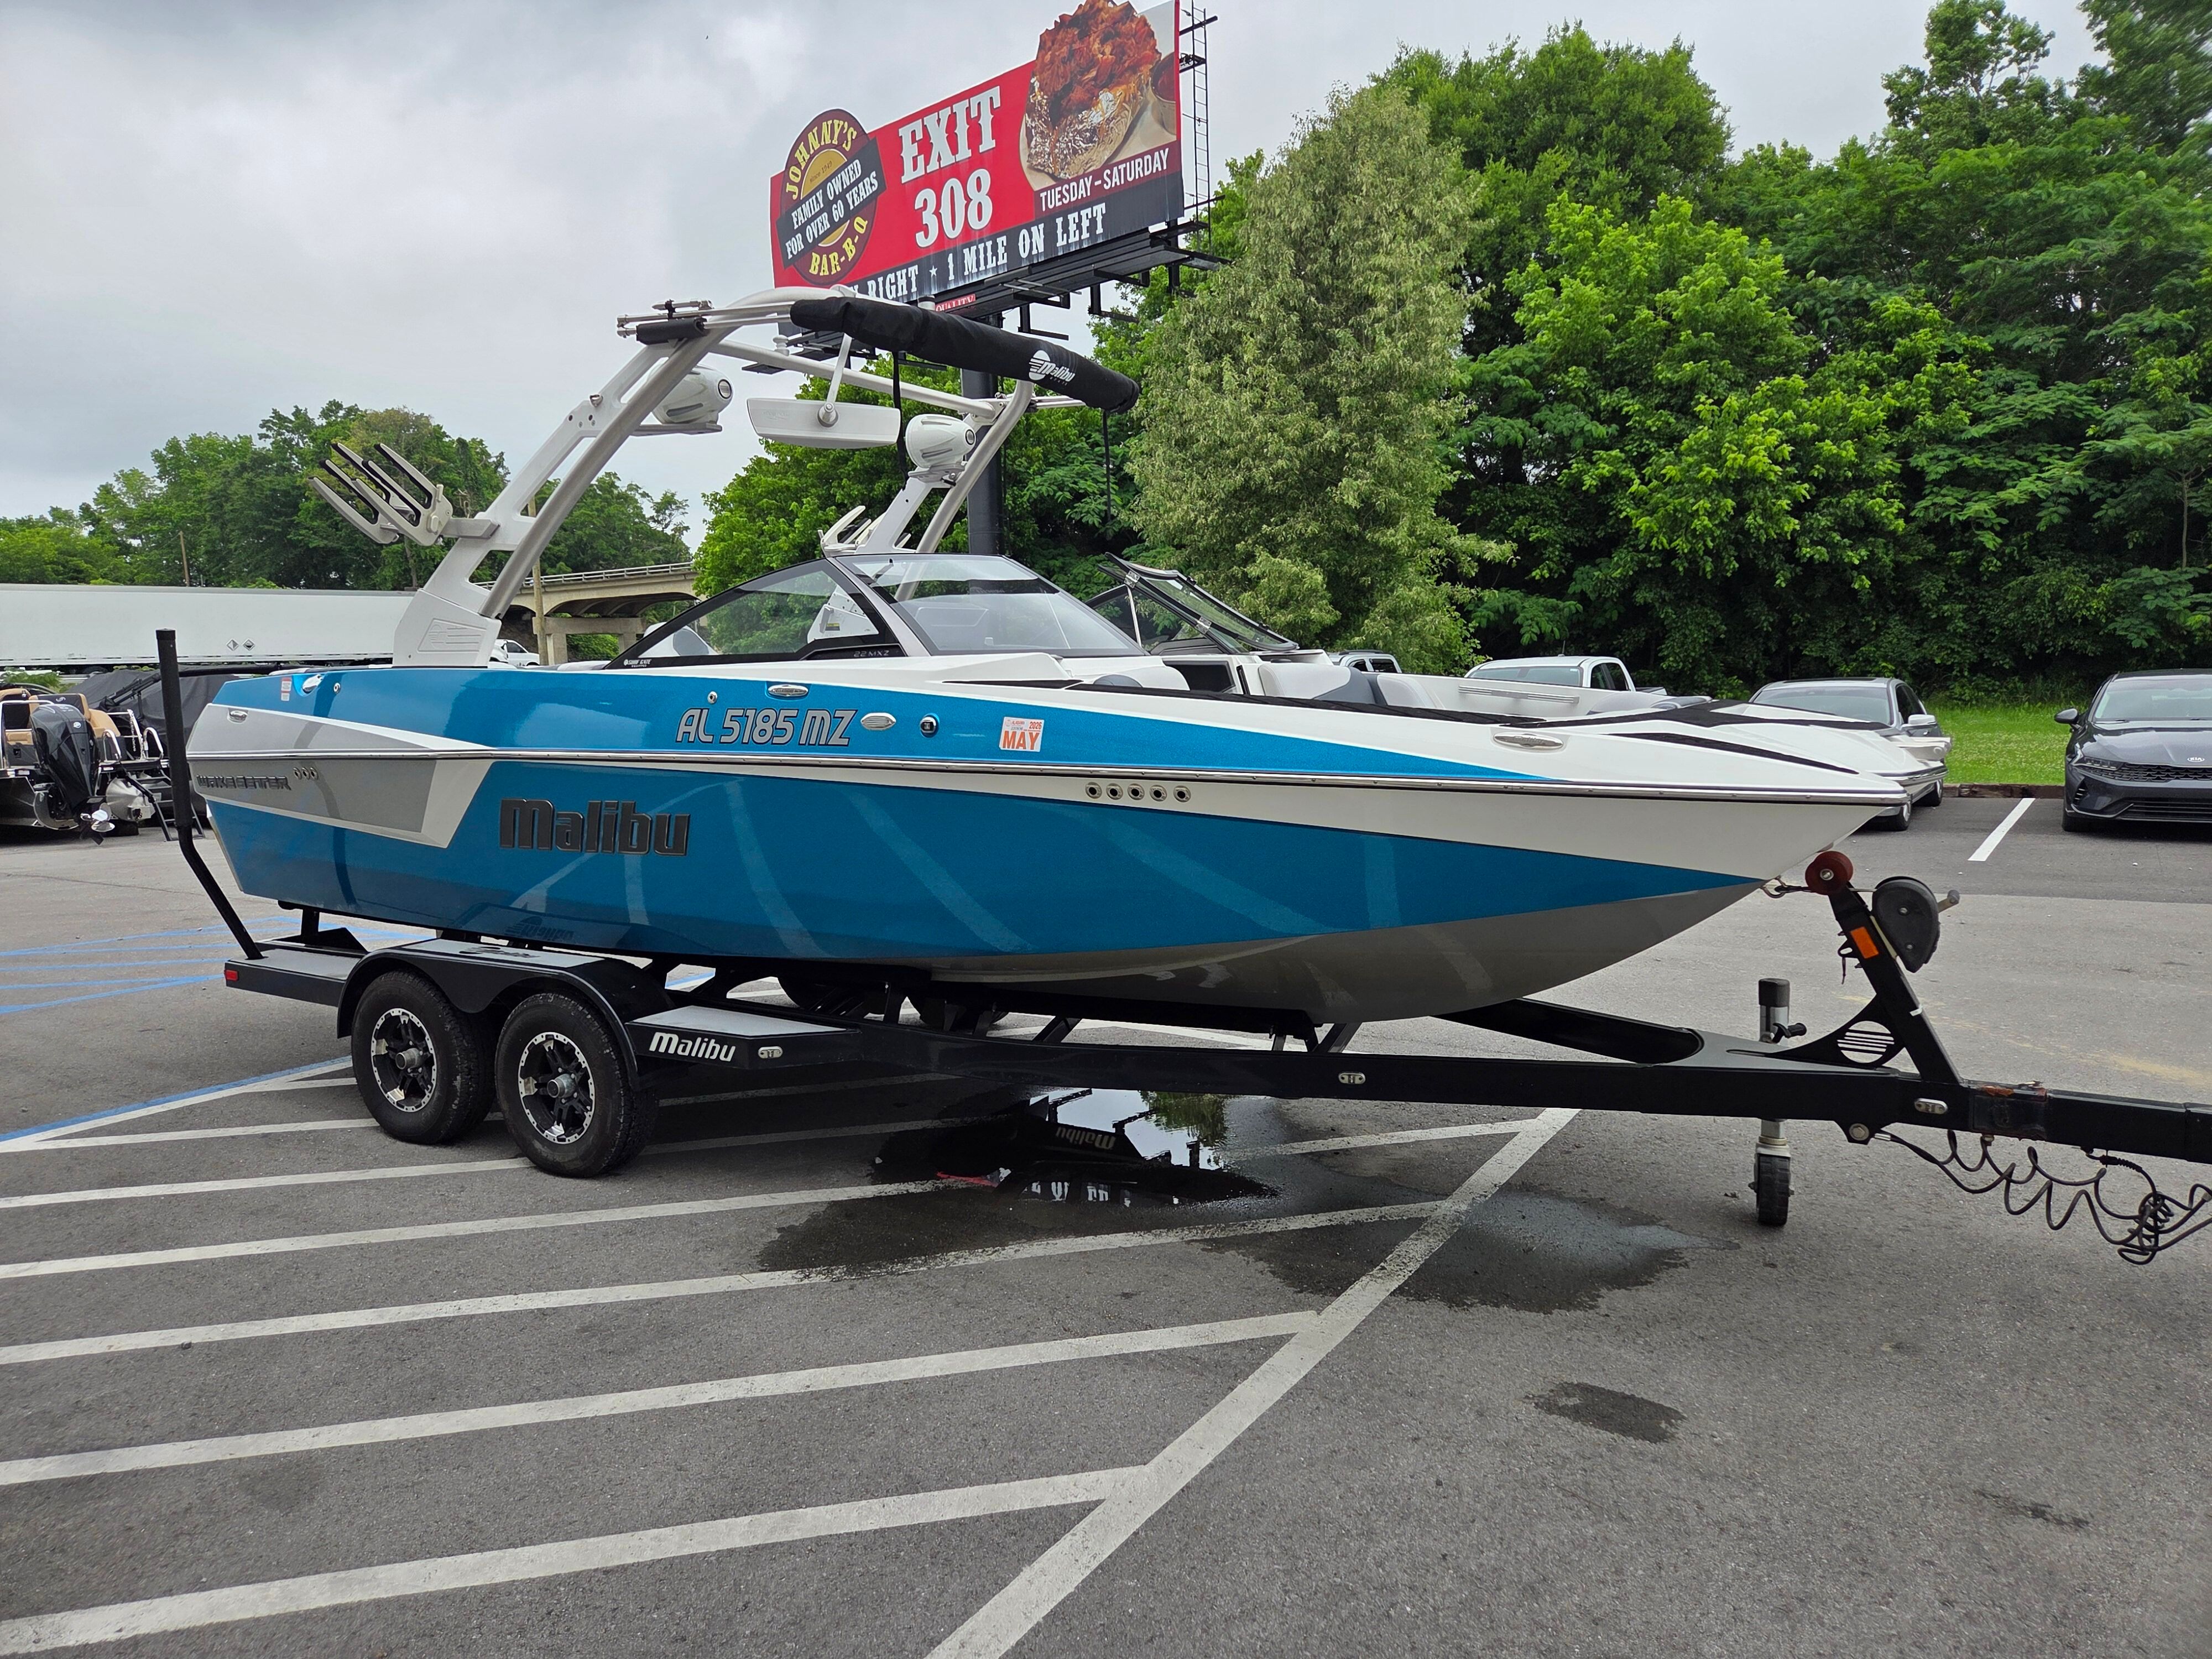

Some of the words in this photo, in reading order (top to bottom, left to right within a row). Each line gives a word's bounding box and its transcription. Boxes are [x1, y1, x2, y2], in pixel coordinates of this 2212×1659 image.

[786, 119, 857, 200] JOHNNY'S
[899, 86, 1000, 184] EXIT
[791, 189, 824, 230] FAMILY
[827, 159, 862, 200] OWNED
[915, 168, 993, 248] 308
[1040, 175, 1093, 211] TUESDAY
[1103, 148, 1169, 190] SATURDAY
[785, 233, 805, 259] FOR
[806, 212, 830, 243] OVER
[832, 200, 844, 222] 60
[846, 171, 878, 211] YEARS
[809, 216, 868, 276] BAR-B-Q
[867, 264, 918, 300] RIGHT
[948, 253, 954, 281] 1
[963, 235, 1008, 275] MILE
[1018, 223, 1044, 258] ON
[1056, 202, 1106, 247] LEFT
[1037, 362, 1076, 382] Malibu
[675, 708, 714, 743] AL
[719, 708, 798, 744] 5185
[799, 708, 858, 747] MZ
[1003, 731, 1040, 750] MAY
[1029, 721, 1042, 729] 2026
[500, 797, 690, 856] Malibu
[649, 1031, 736, 1062] Malibu
